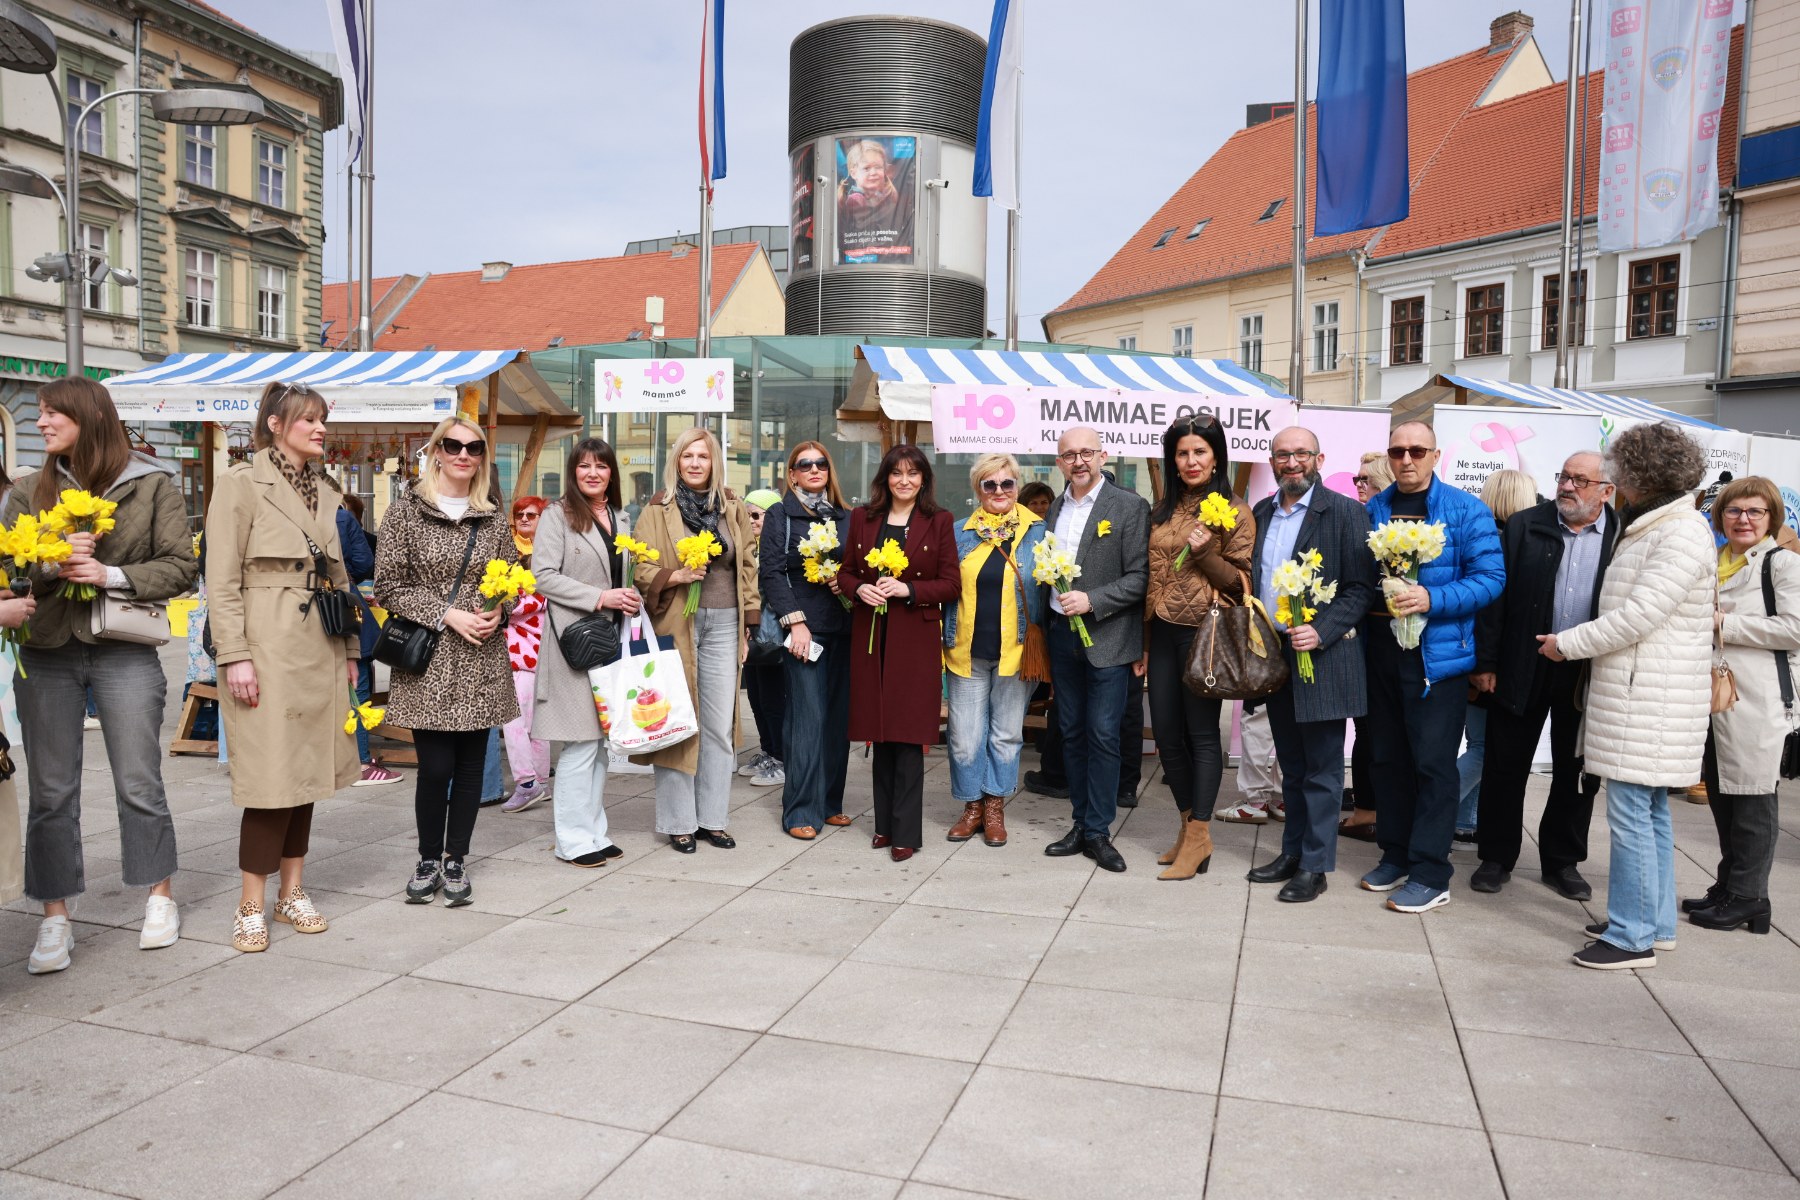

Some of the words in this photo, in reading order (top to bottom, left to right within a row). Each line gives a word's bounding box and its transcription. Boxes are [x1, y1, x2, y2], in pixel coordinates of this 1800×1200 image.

[0, 357, 112, 381] NTRANA
[642, 388, 686, 399] mammae
[213, 400, 249, 410] GRAD
[1040, 399, 1166, 425] MAMMAE
[989, 436, 1018, 444] OSIJEK
[1100, 432, 1126, 444] ENA
[1457, 460, 1469, 468] Ne
[1462, 485, 1481, 494] čeka
